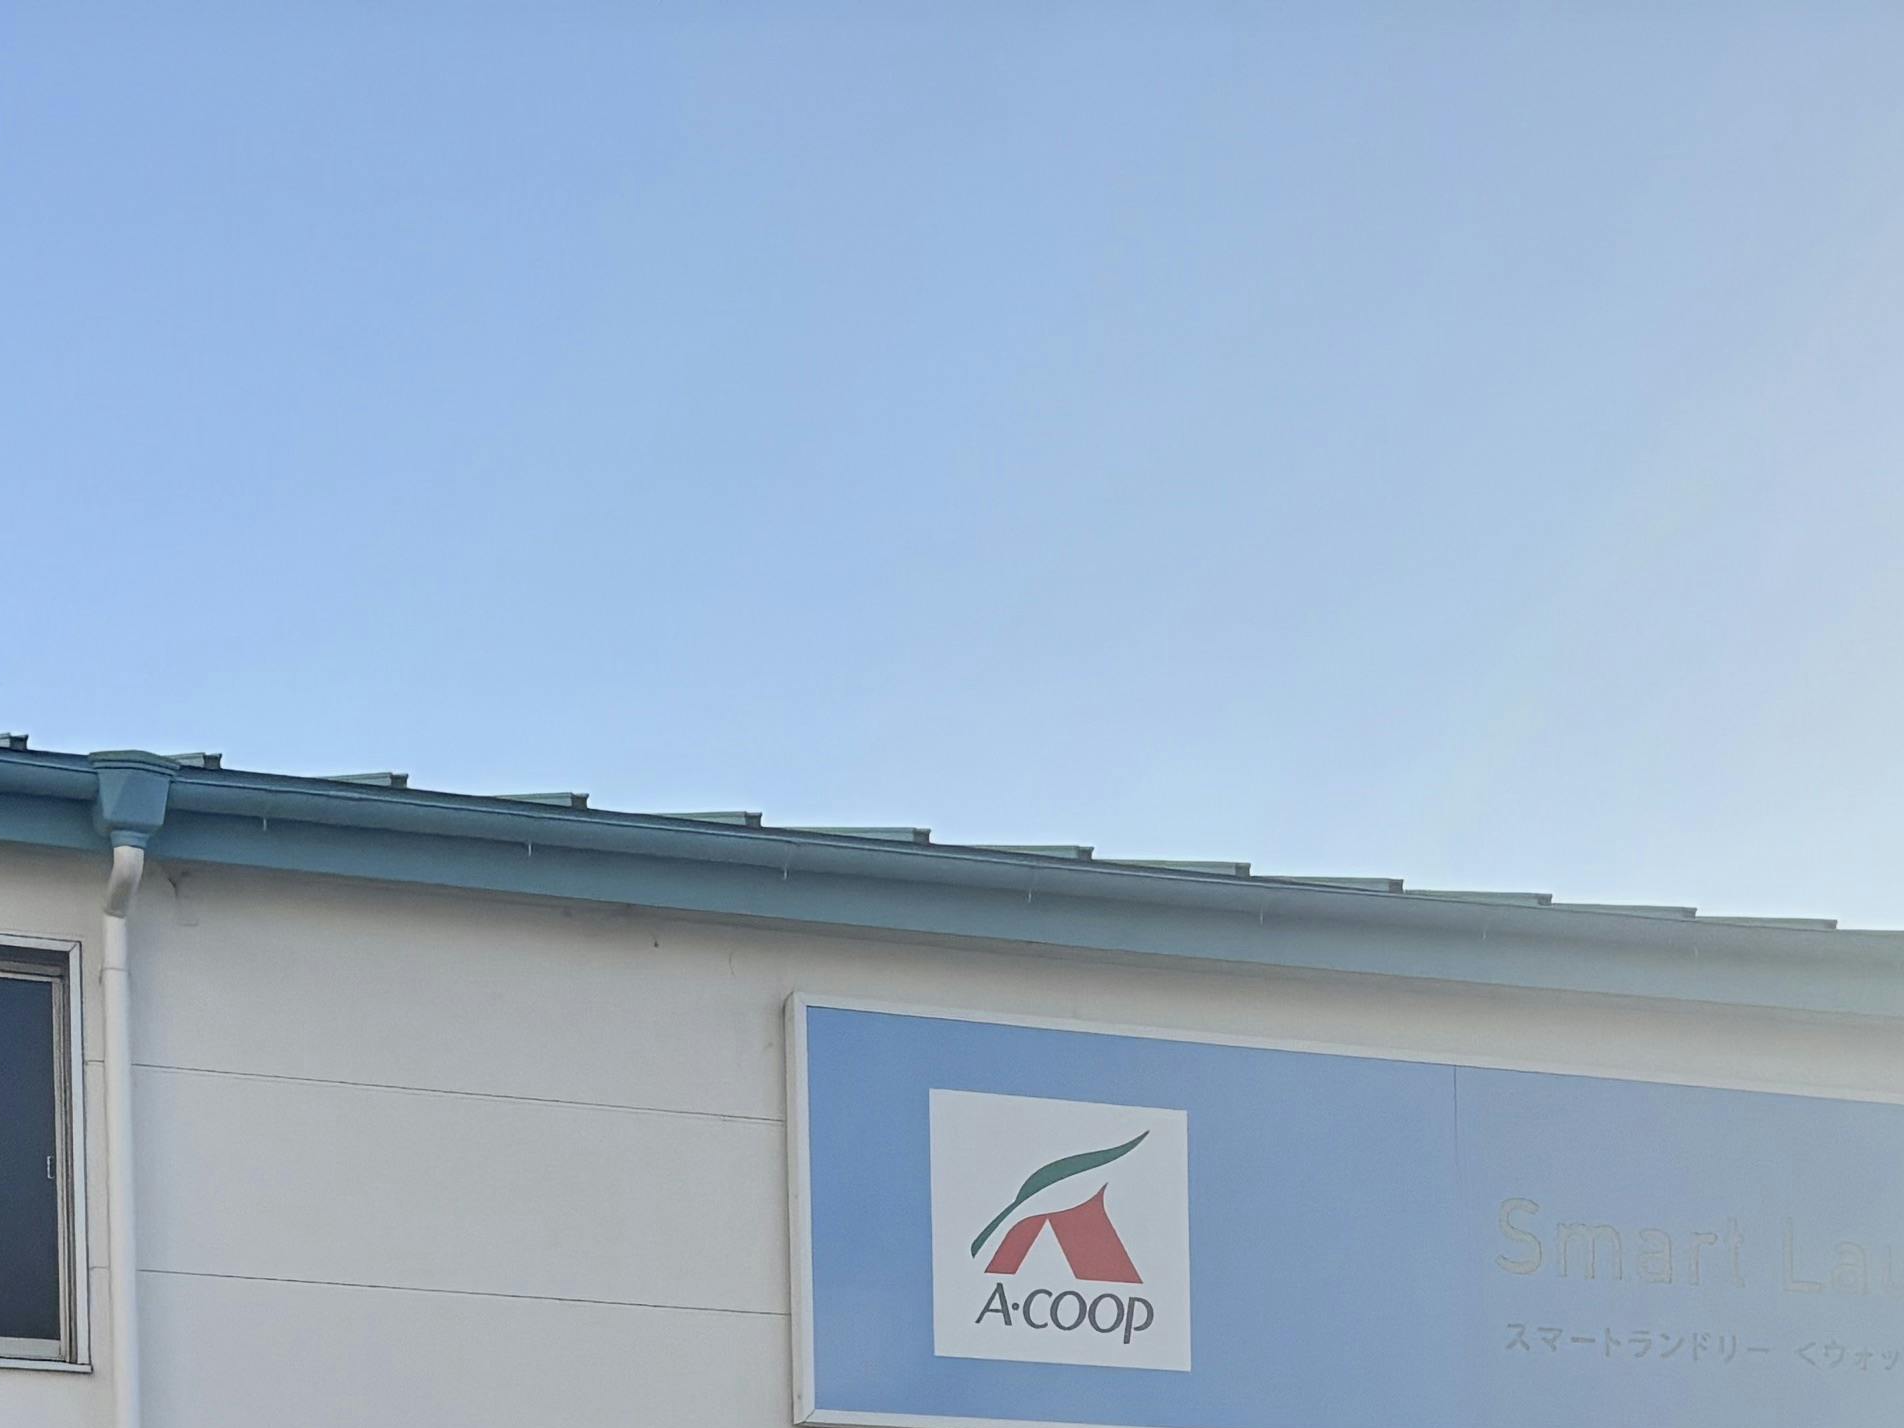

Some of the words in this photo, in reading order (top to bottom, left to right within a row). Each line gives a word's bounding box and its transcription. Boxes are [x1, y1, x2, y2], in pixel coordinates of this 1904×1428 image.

[1495, 1196, 1746, 1288] Smart
[1504, 1322, 1771, 1364] スマートランドリー
